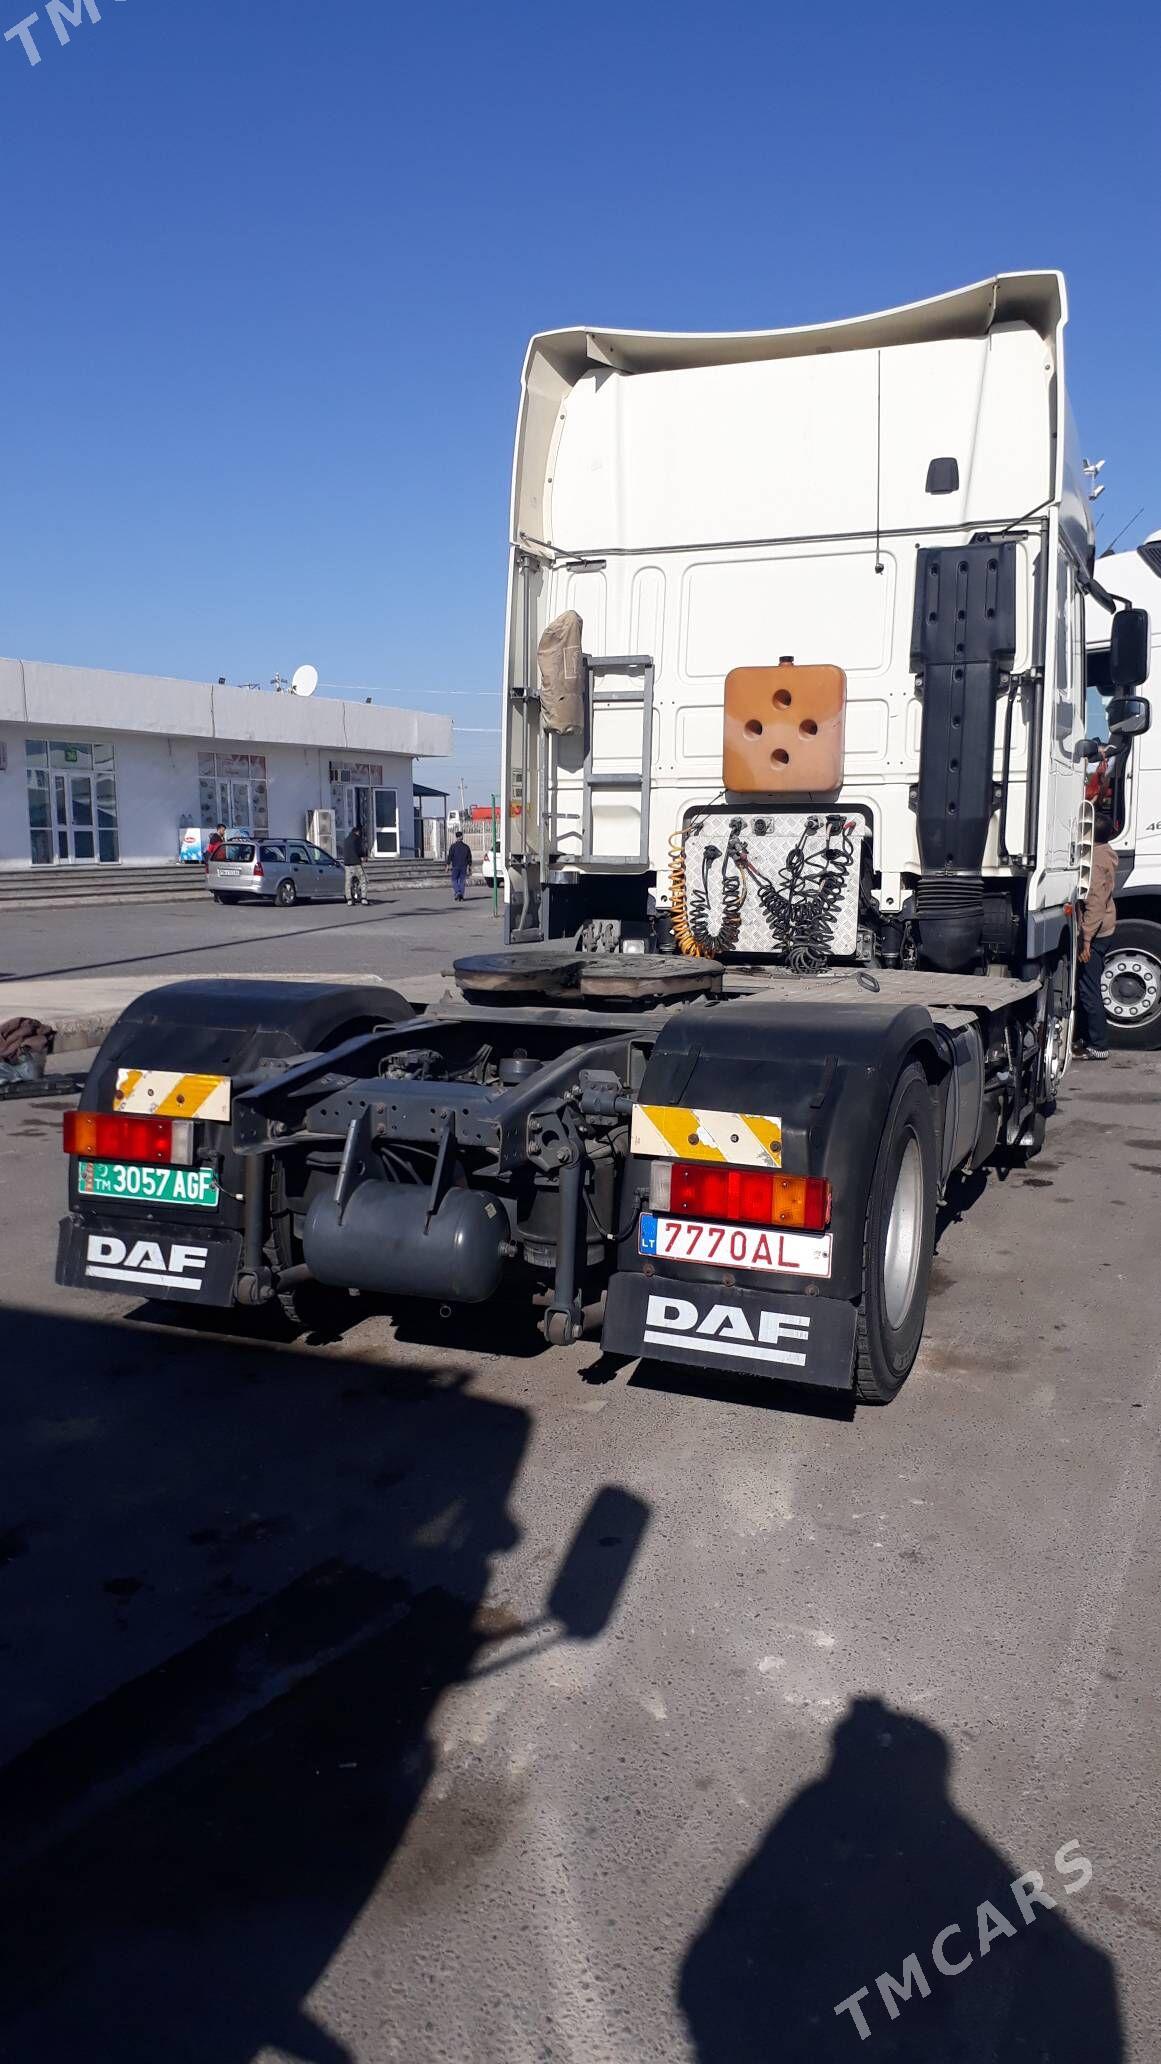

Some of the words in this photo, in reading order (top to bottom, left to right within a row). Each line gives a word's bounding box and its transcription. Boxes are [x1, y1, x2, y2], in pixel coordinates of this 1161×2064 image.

[95, 1178, 111, 1191] TM
[112, 1165, 171, 1196] 3057
[87, 1235, 208, 1273] DAF
[642, 1238, 655, 1249] LT
[665, 1223, 800, 1268] 7770AL
[645, 1295, 811, 1345] DAF
